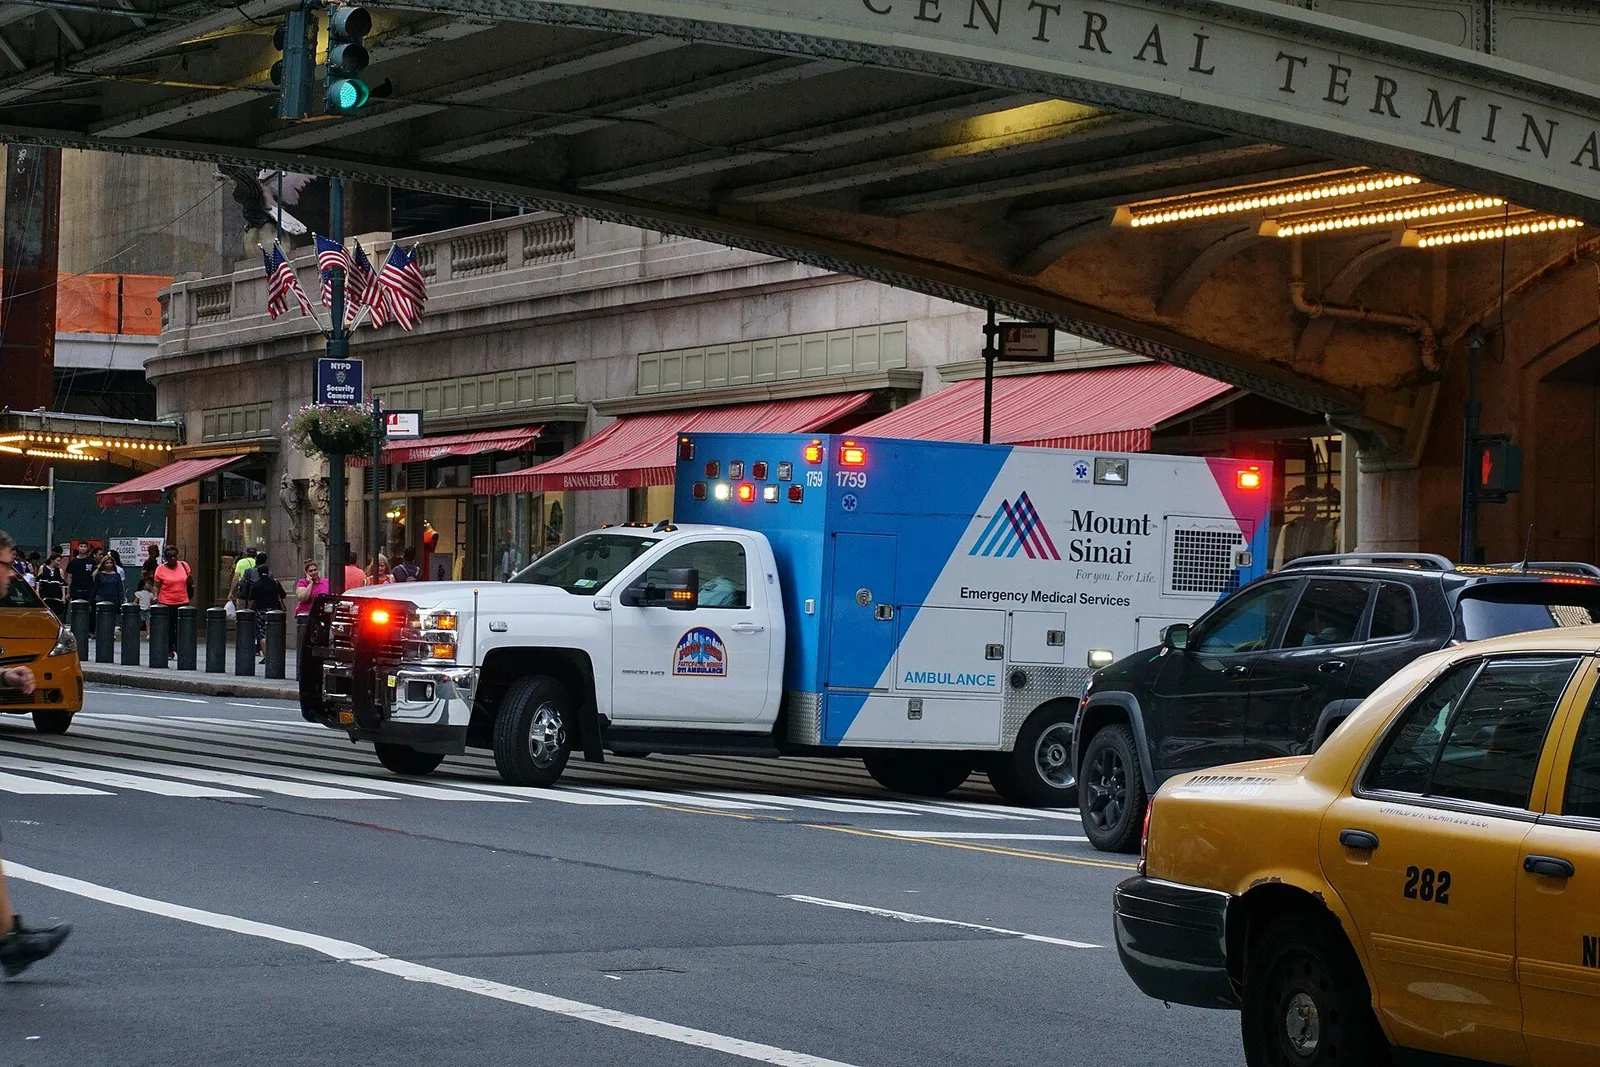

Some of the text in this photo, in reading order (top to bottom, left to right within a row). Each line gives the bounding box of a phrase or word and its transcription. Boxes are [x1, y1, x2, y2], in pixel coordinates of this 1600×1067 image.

[1275, 50, 1600, 171] TERMINA
[330, 362, 351, 370] NYPD
[326, 384, 355, 393] Security
[563, 473, 619, 488] BANANA REPUBLIC
[806, 471, 823, 488] 1759
[835, 471, 867, 488] 1759
[1069, 509, 1151, 536] Mount
[1069, 538, 1132, 565] Sinai
[1075, 568, 1156, 584] For you. For Life.
[960, 587, 1130, 607] Emergency Medical Services
[904, 671, 996, 687] AMBULANCE
[1403, 865, 1452, 905] 282
